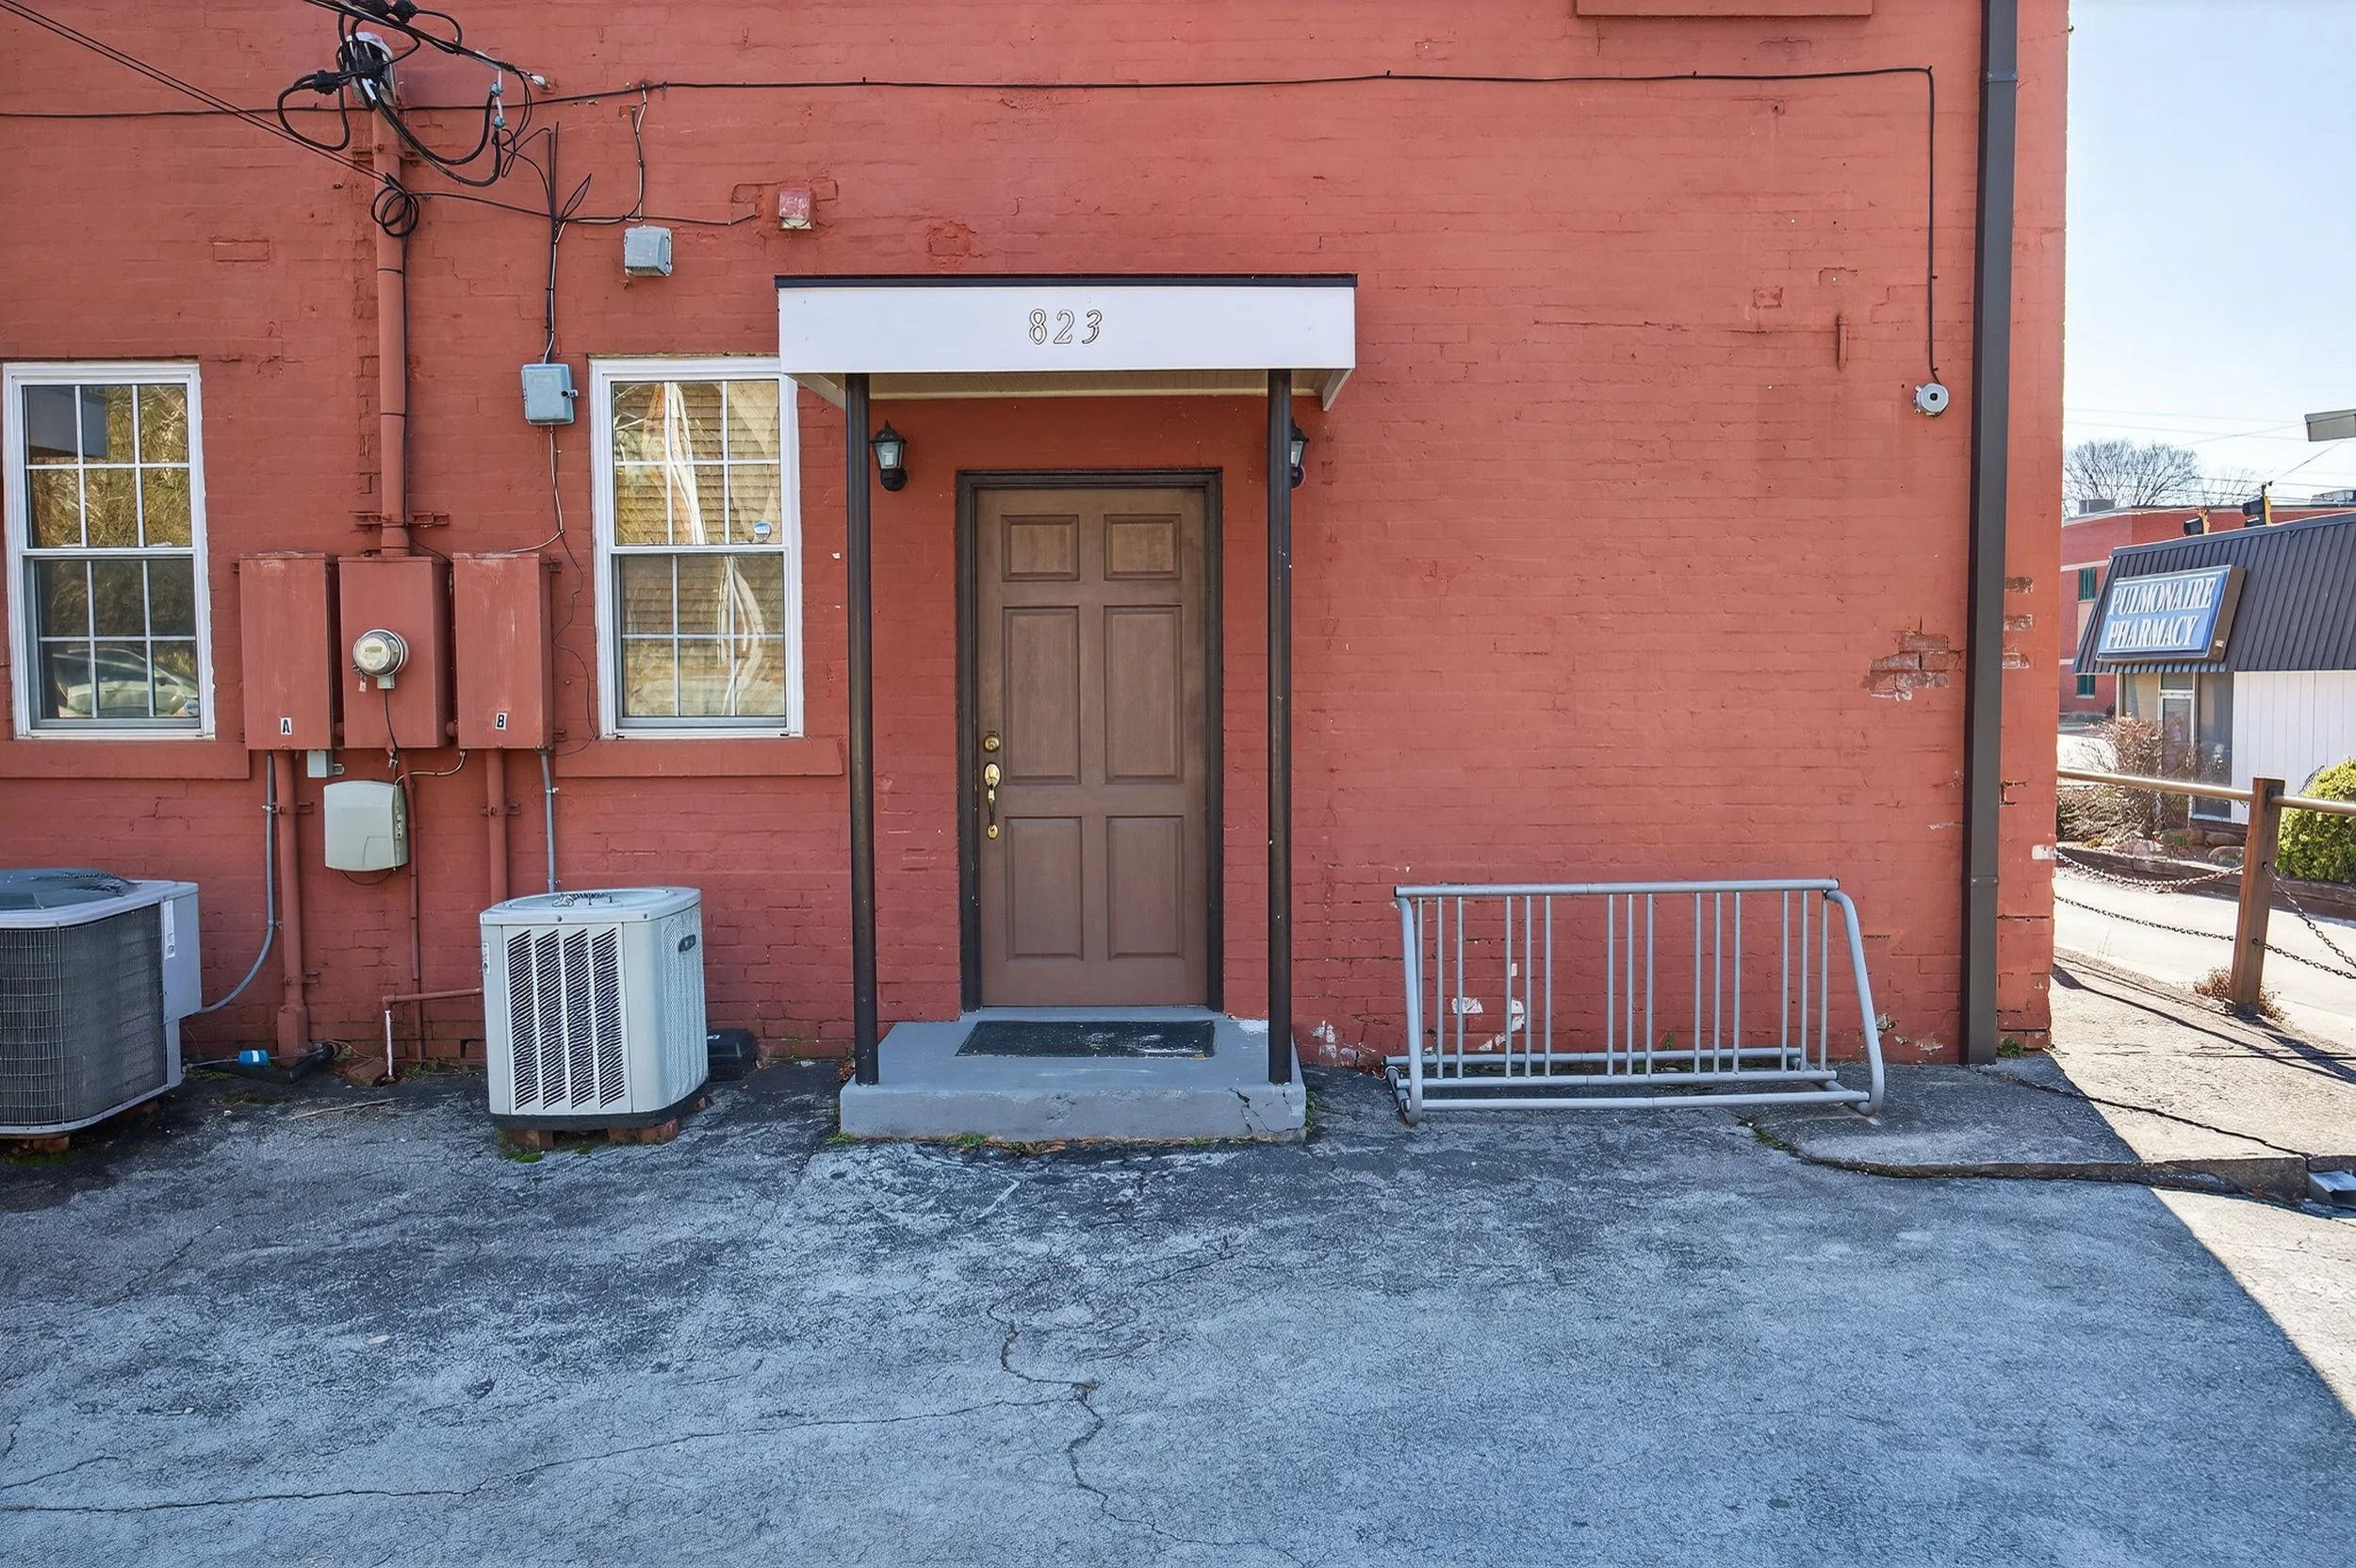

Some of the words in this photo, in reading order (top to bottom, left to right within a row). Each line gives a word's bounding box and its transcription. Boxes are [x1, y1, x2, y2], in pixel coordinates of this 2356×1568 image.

[1029, 308, 1103, 345] 823
[2107, 578, 2217, 615] PULMONAIRE
[2106, 615, 2200, 648] PHARMACY
[282, 719, 291, 733] A
[497, 713, 505, 728] B
